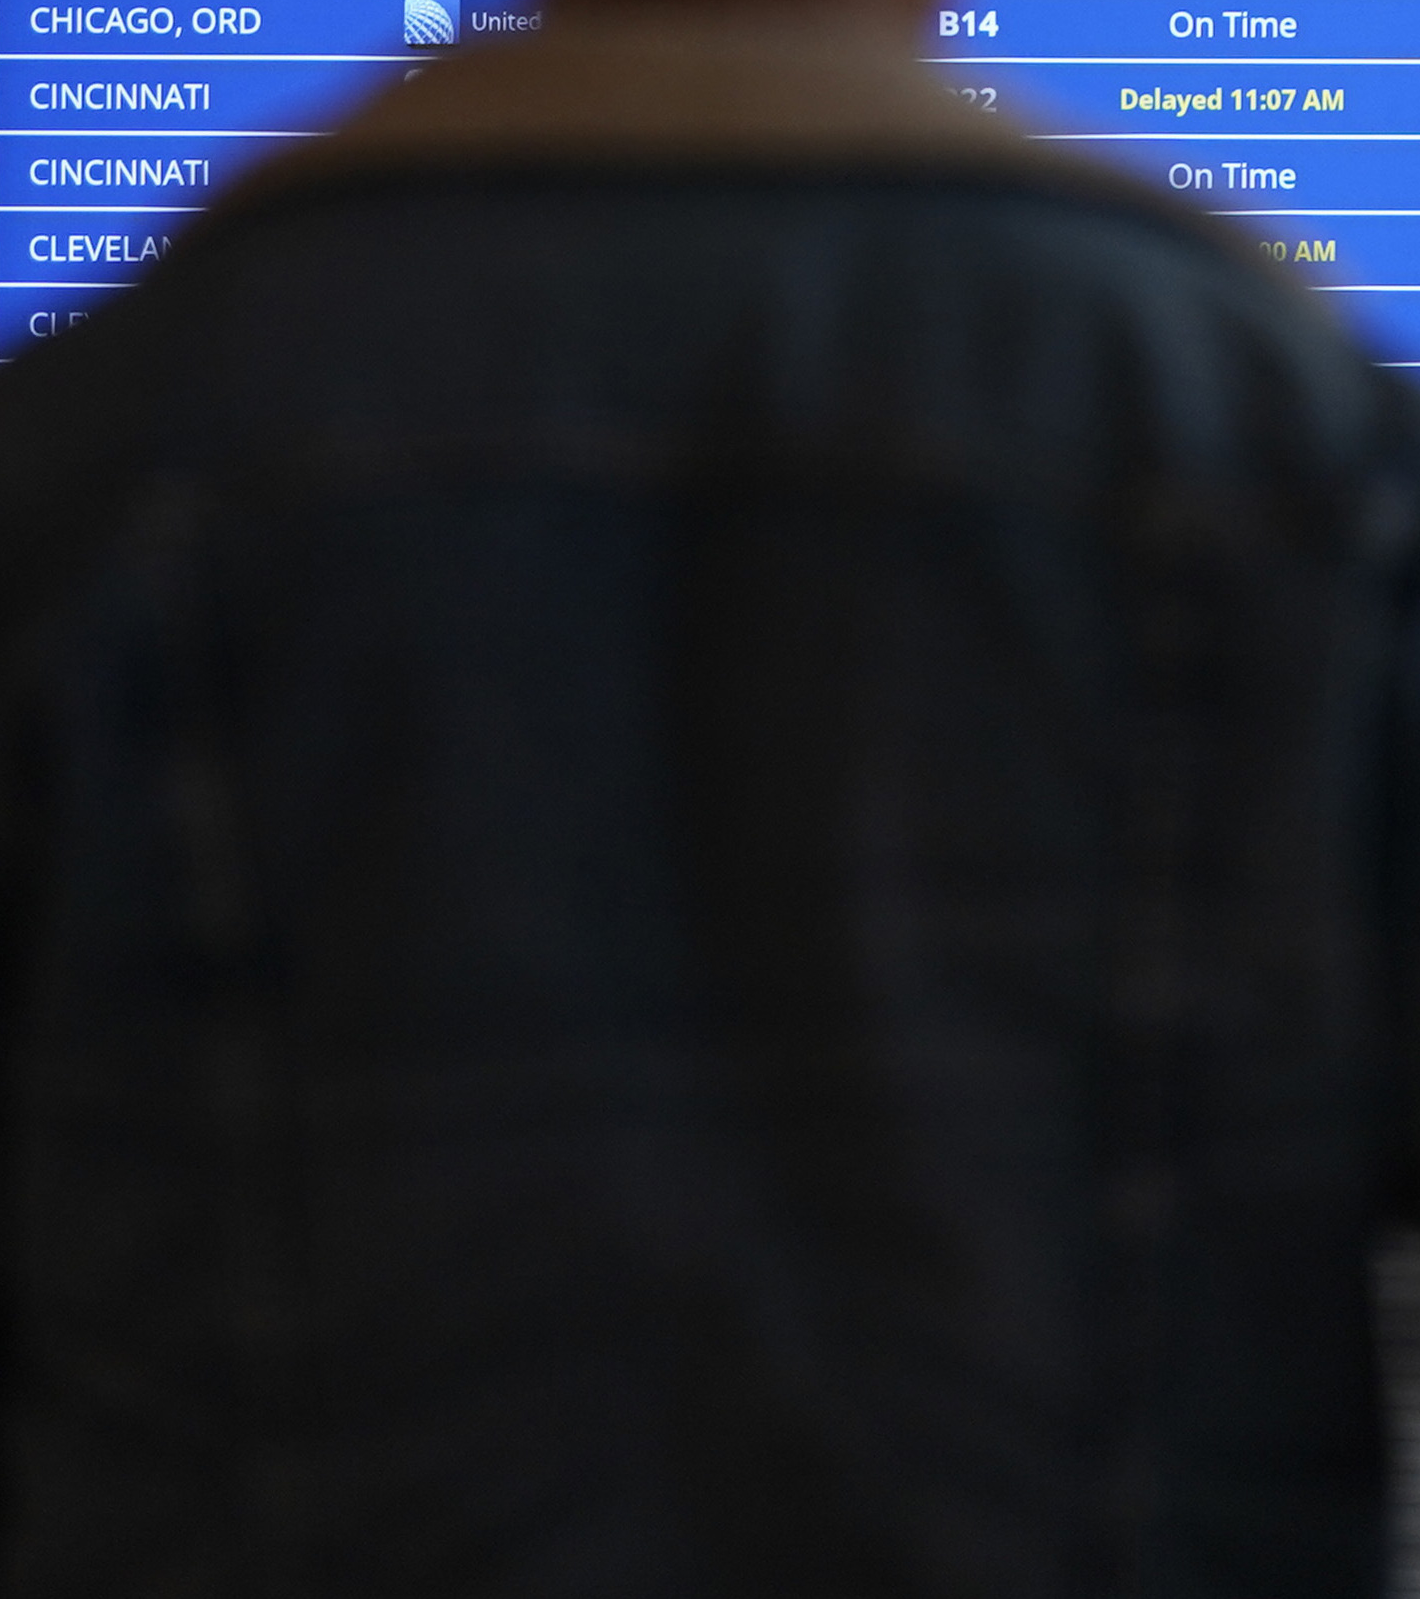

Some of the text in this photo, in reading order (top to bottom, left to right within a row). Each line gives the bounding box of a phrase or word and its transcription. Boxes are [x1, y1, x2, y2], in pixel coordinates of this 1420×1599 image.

[29, 82, 1344, 118] CINCINNATI Delayed 11:07 AM
